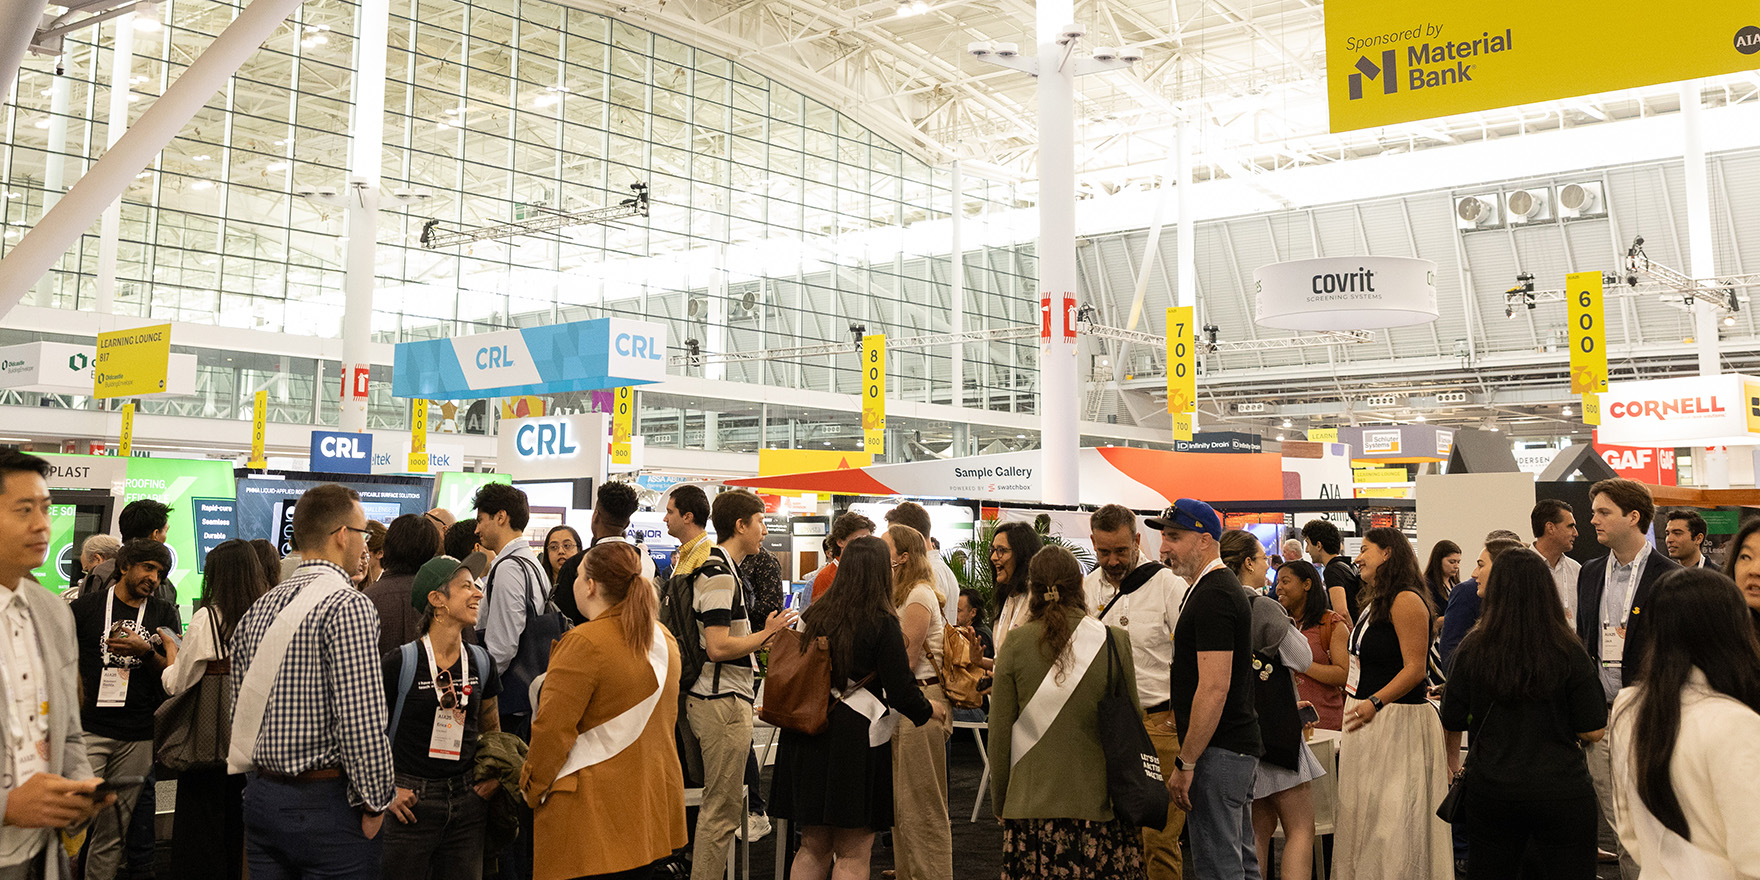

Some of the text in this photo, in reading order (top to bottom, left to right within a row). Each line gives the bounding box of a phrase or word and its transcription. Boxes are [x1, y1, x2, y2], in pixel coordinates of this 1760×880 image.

[1346, 23, 1443, 53] Sponsored by
[1407, 28, 1512, 67] Material
[1409, 61, 1473, 90] Bank
[1312, 267, 1375, 294] covrit
[1306, 294, 1348, 302] SCREENING
[1579, 291, 1594, 353] 600
[100, 332, 162, 349] LEARNING LOUNGE
[615, 332, 662, 361] CRL
[1175, 323, 1186, 378] 700
[476, 345, 512, 370] CRL
[869, 349, 878, 398] 800
[1586, 403, 1597, 414] 600
[1609, 396, 1725, 420] CORNELL
[1176, 422, 1189, 431] 700
[320, 436, 365, 459] CRL
[516, 423, 576, 456] CRL
[867, 437, 880, 446] 800
[1189, 442, 1210, 450] Infinity
[428, 453, 450, 466] ltek
[1601, 449, 1652, 470] GAF
[954, 466, 1032, 480] Sample Gallery
[201, 504, 232, 512] Rapid-cure
[201, 518, 230, 526] Seamless
[203, 532, 226, 540] Durable
